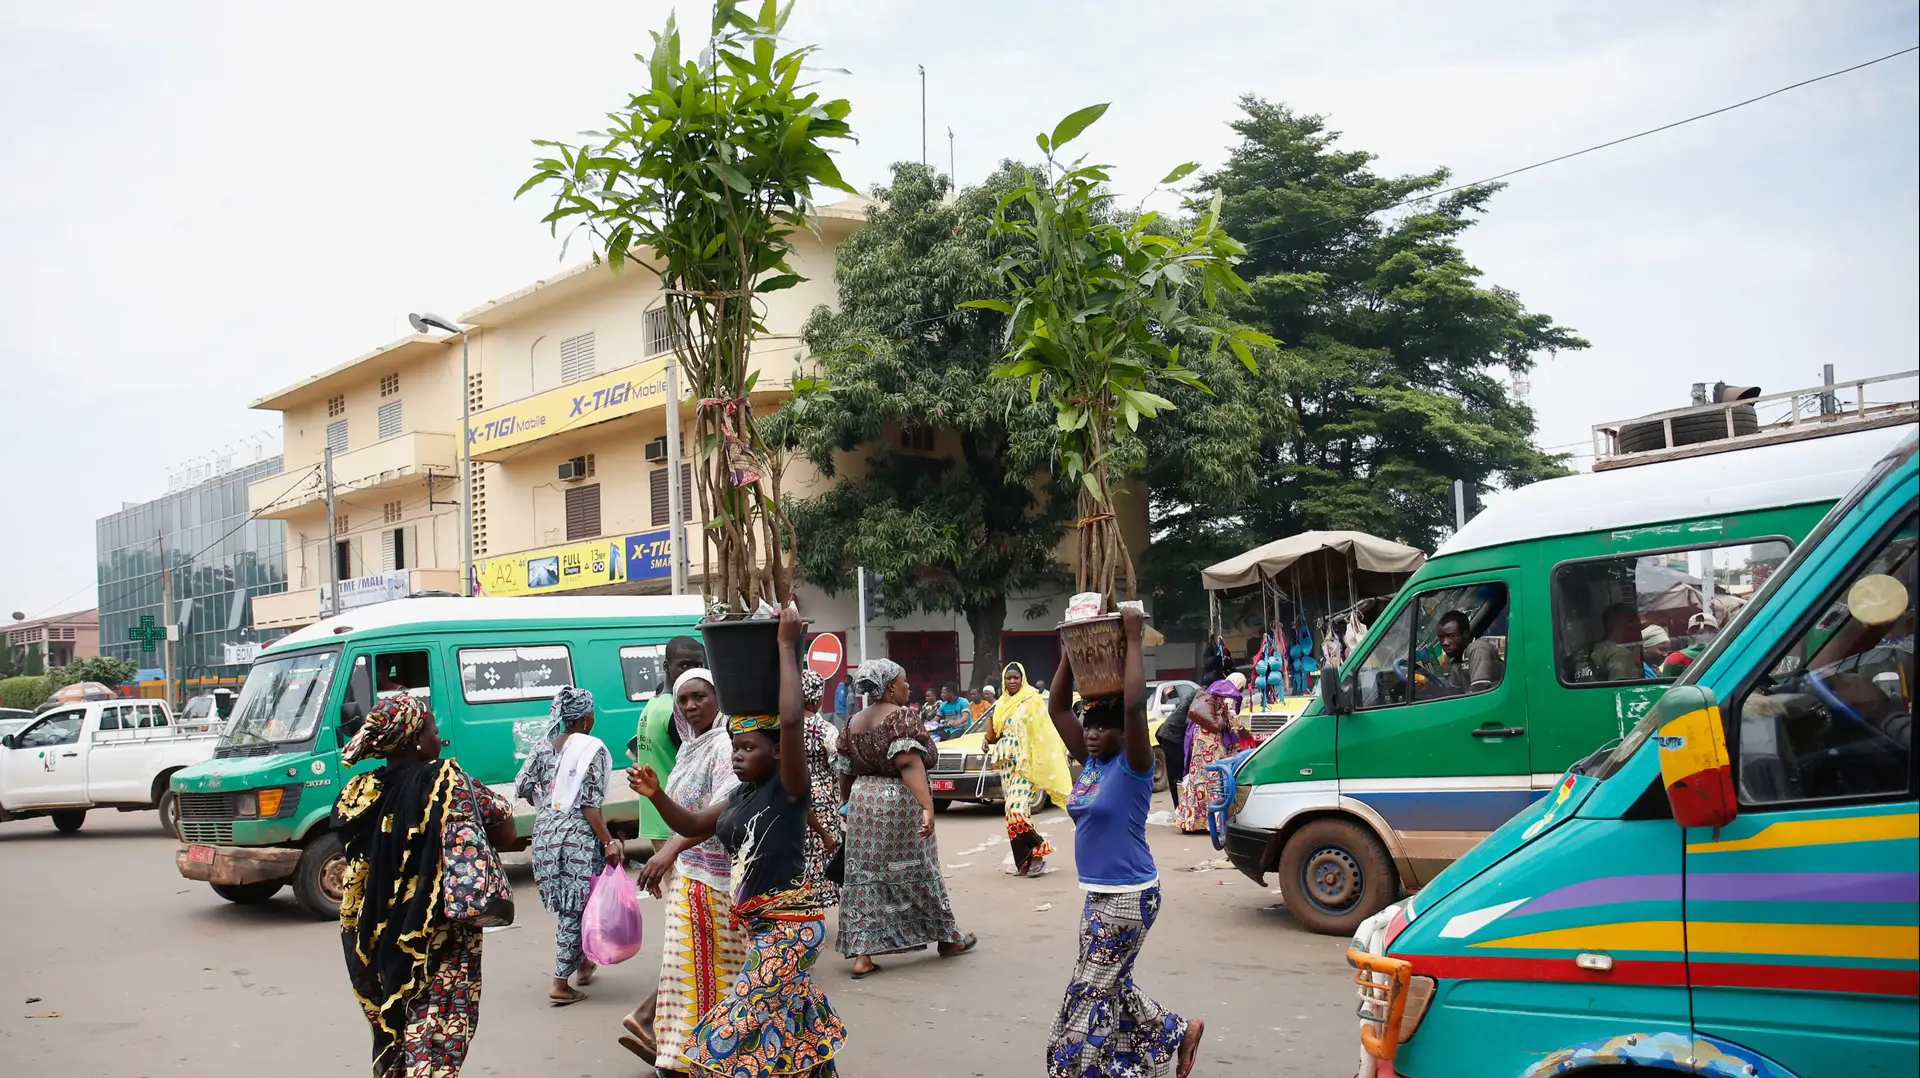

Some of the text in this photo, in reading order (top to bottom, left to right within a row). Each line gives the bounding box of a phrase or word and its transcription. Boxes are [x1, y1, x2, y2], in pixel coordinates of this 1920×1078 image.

[569, 379, 667, 418] X-TIGI Mobile
[468, 413, 546, 445] X-TIGI Mobile
[563, 553, 580, 567] FULL
[631, 539, 672, 561] X-TIG
[495, 563, 512, 585] A2
[650, 557, 672, 569] SMAR
